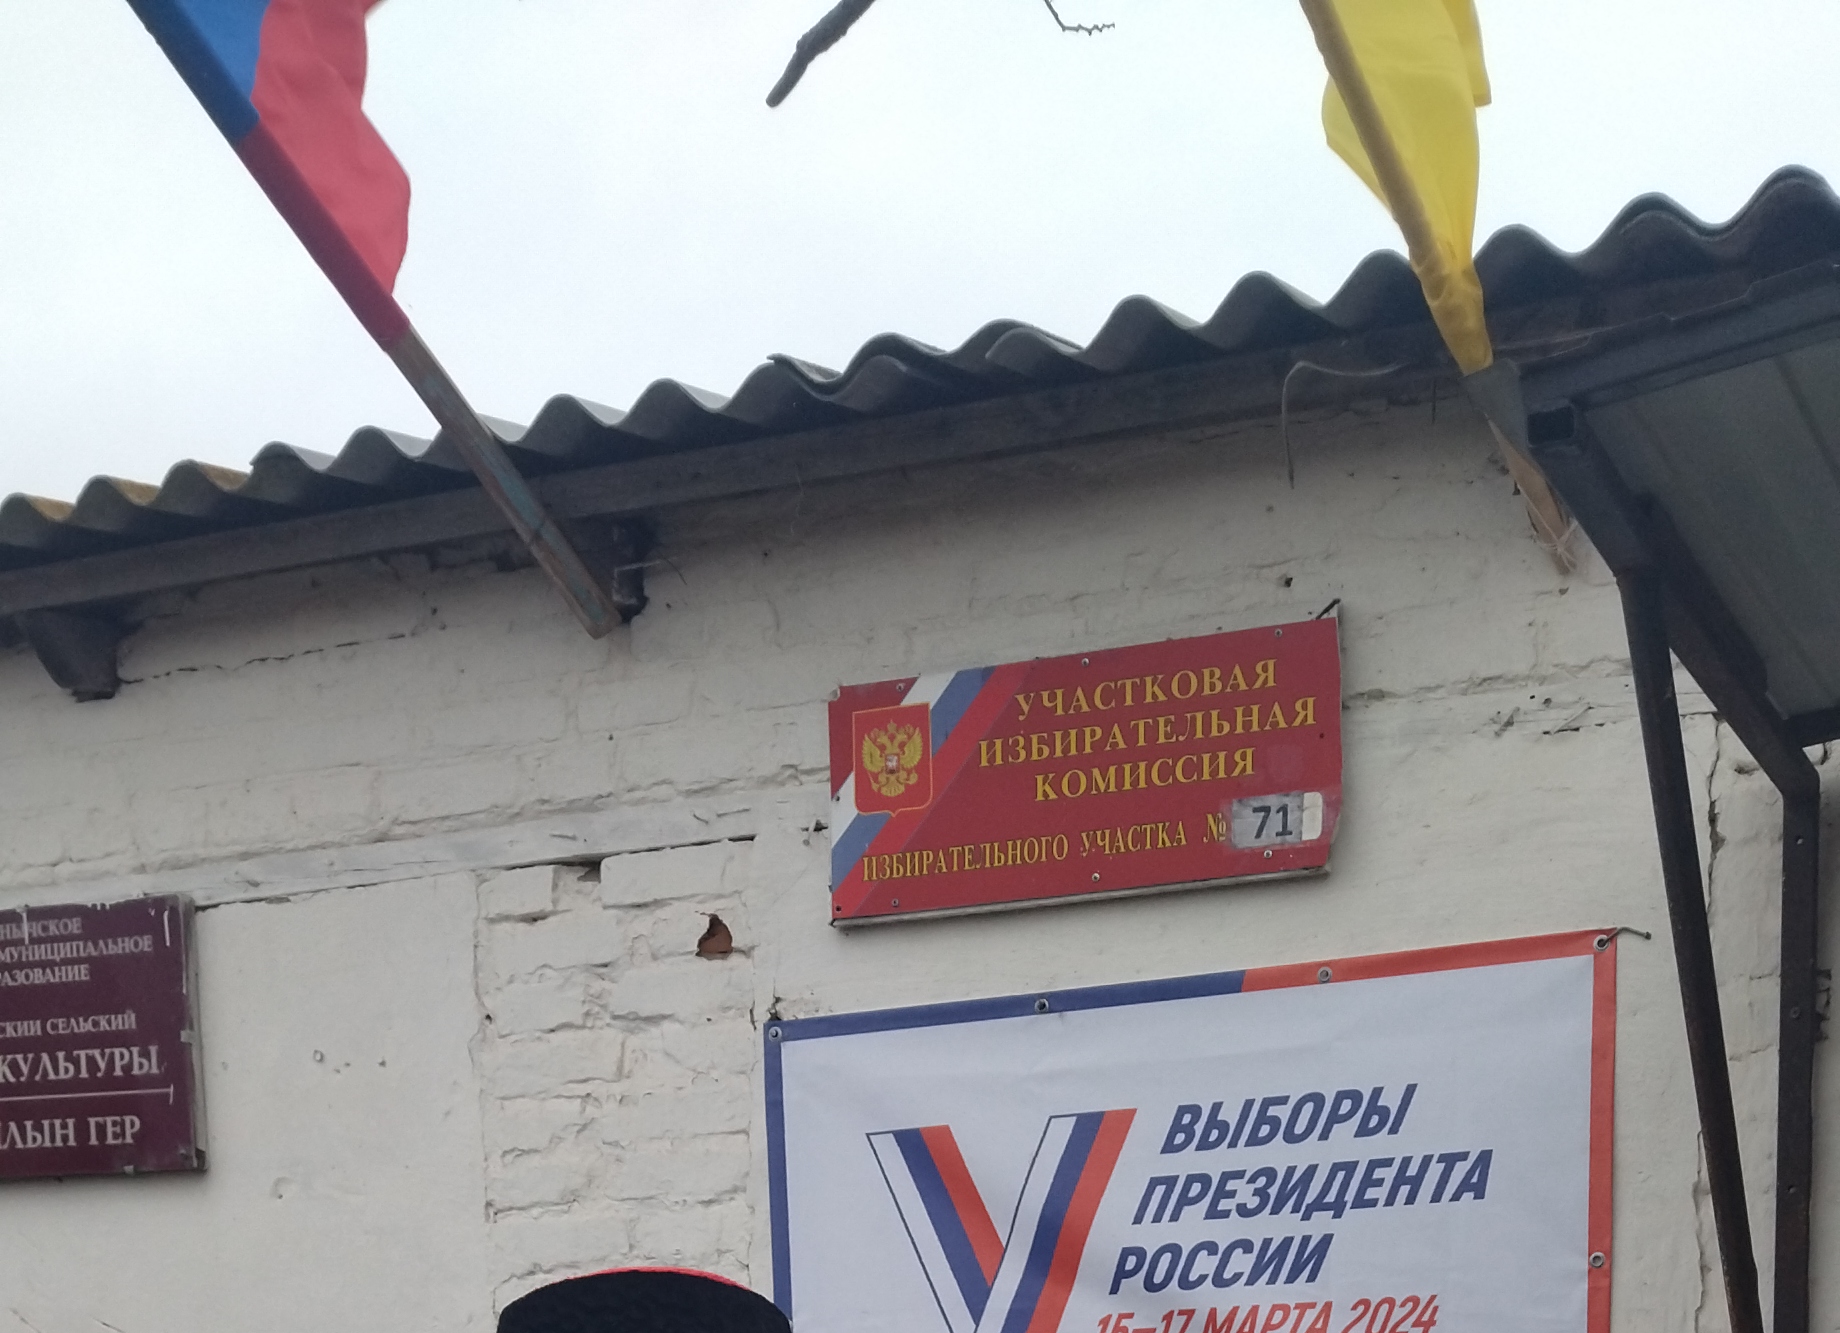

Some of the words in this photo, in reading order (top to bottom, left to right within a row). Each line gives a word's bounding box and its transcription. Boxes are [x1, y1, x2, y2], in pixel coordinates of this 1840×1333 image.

[1014, 658, 1278, 721] УЧАСТКОВАЯ
[978, 696, 1317, 768] ИЗБИРАТЕЛЬНАЯ
[1034, 747, 1256, 802] КОМИССИЯ
[862, 834, 1069, 881] ИЗБИРАТЕЛЬНОГО
[1080, 820, 1187, 857] УЧАСТКА
[1203, 812, 1227, 844] №
[1252, 804, 1293, 840] 71
[0, 935, 153, 963] МУНИЦИПАЛЬНОЕ
[0, 964, 90, 986] АЗОВАНИЕ
[46, 1009, 136, 1034] СЕЛЬСКИЙ
[0, 1045, 159, 1083] КУЛЬТУРЫ
[0, 1117, 76, 1150] ЛЫН
[87, 1115, 141, 1145] ГЕР
[1160, 1083, 1418, 1154] ВЫБОРЫ
[1132, 1149, 1493, 1225] ПРЕЗИДЕНТА
[1109, 1233, 1334, 1295] РОССИИ
